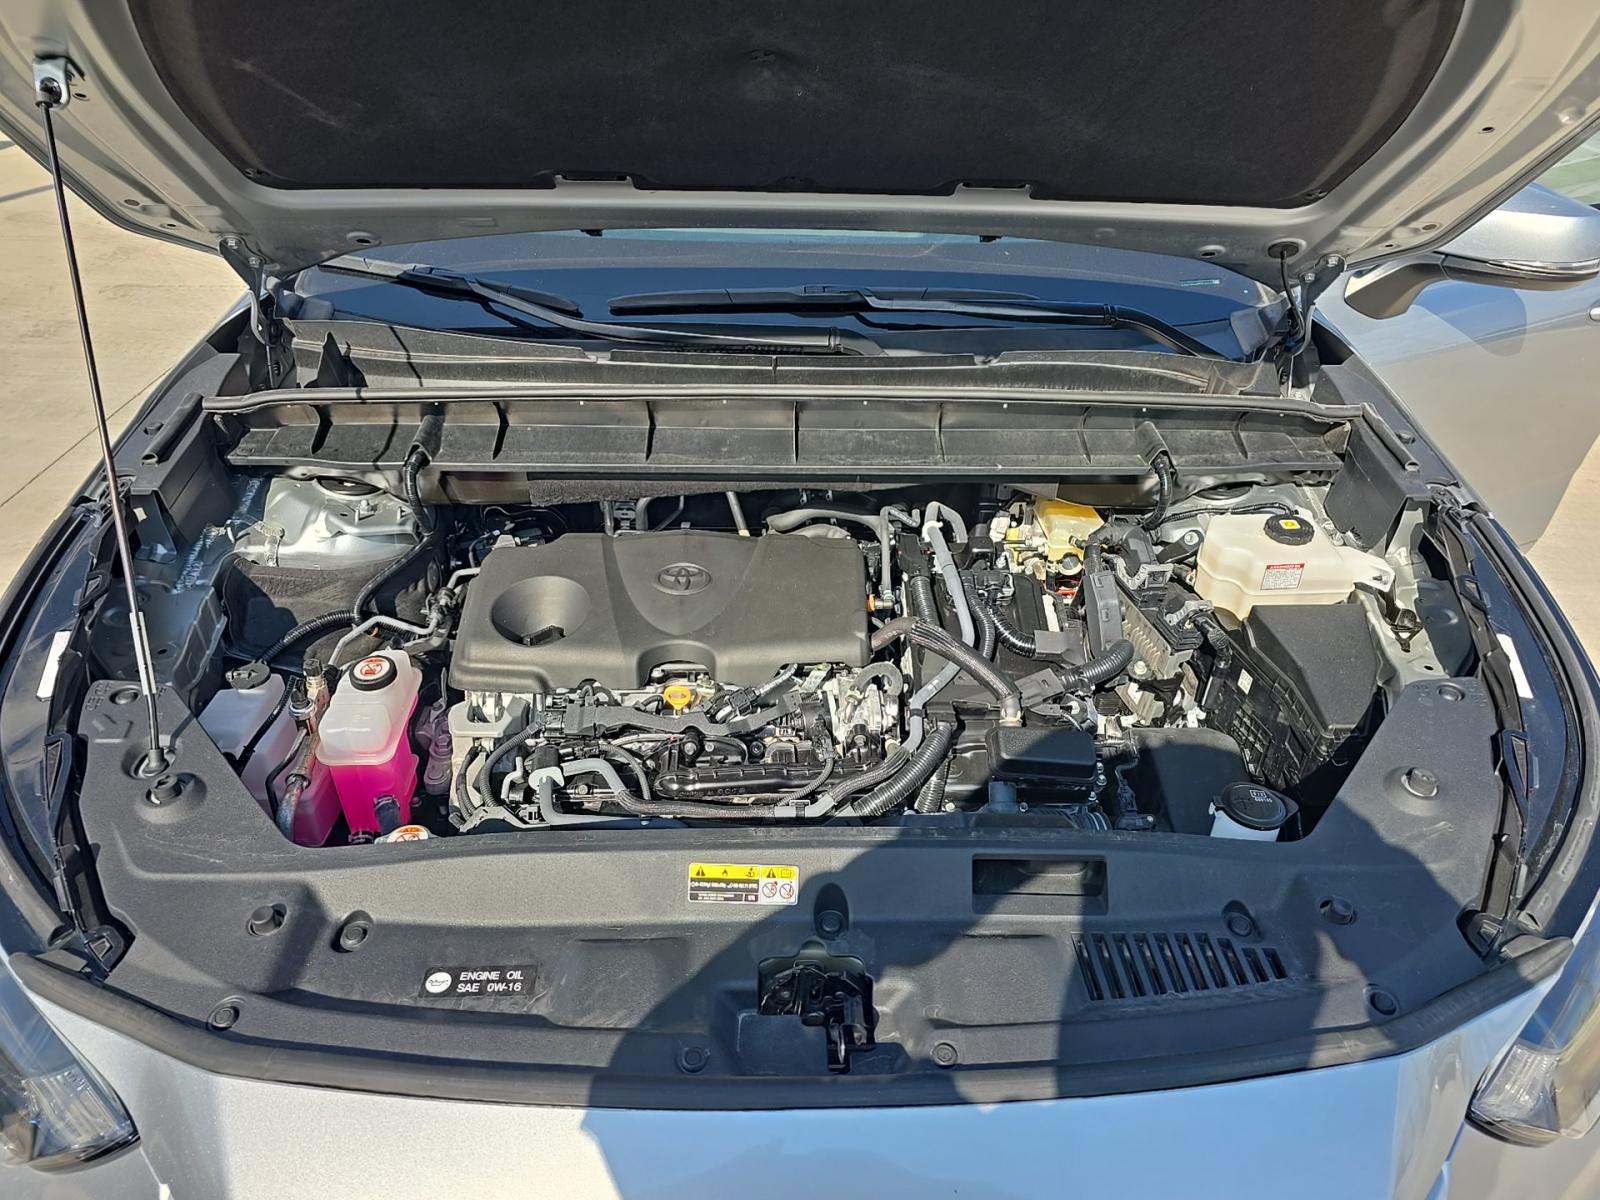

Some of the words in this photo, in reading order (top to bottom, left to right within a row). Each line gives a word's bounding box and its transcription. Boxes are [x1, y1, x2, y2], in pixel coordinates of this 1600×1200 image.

[460, 971, 500, 981] ENGINE
[507, 970, 524, 980] OIL
[456, 982, 480, 993] SAE
[487, 981, 522, 992] 0W-16
